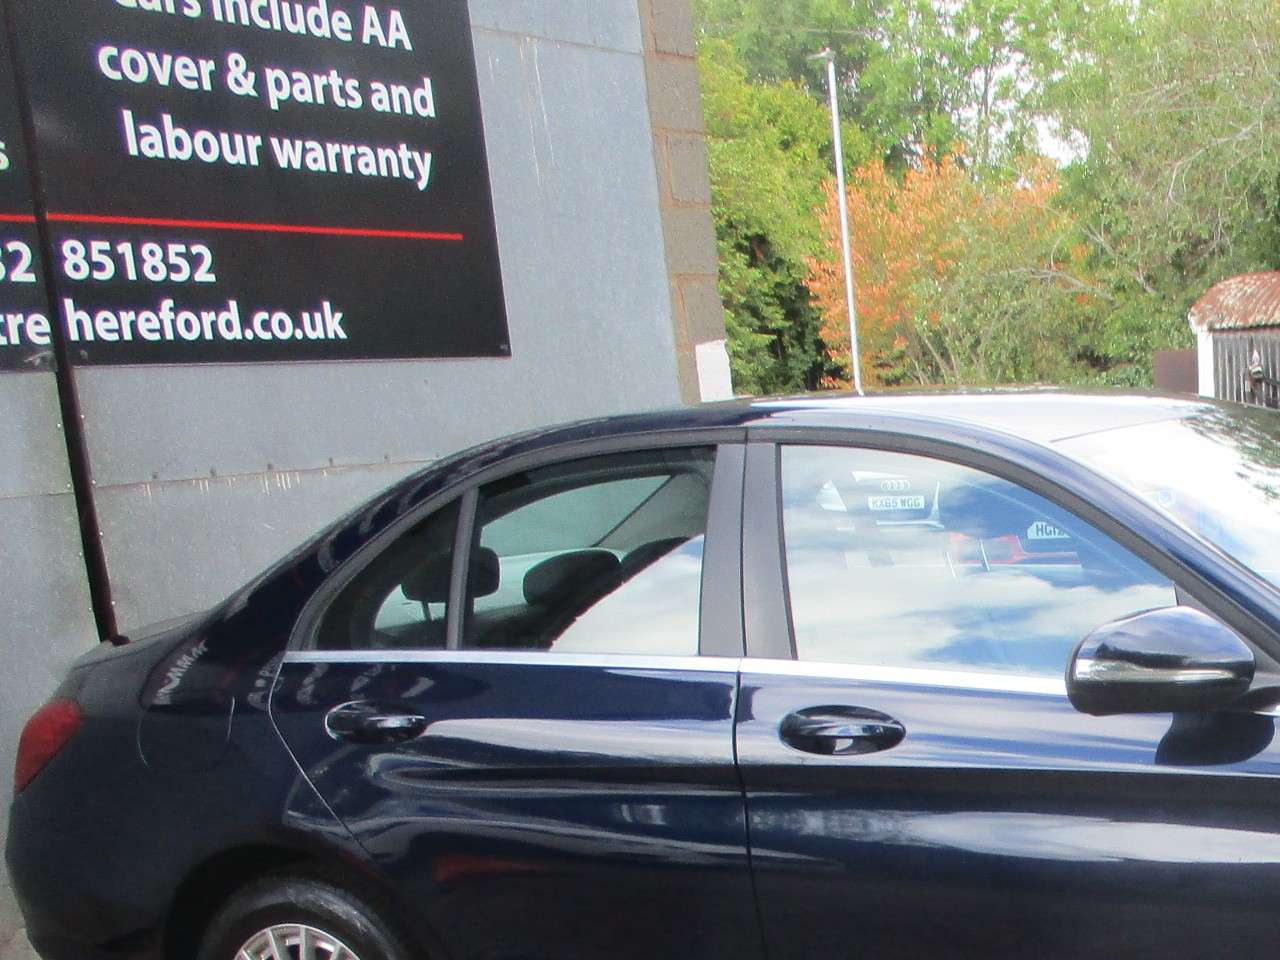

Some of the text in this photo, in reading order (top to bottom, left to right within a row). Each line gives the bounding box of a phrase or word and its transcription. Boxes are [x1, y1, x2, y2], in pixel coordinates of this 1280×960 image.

[362, 5, 413, 51] AA
[98, 45, 436, 118] cover & parts and
[122, 108, 432, 192] labour warranty
[0, 239, 216, 282] 2 851852
